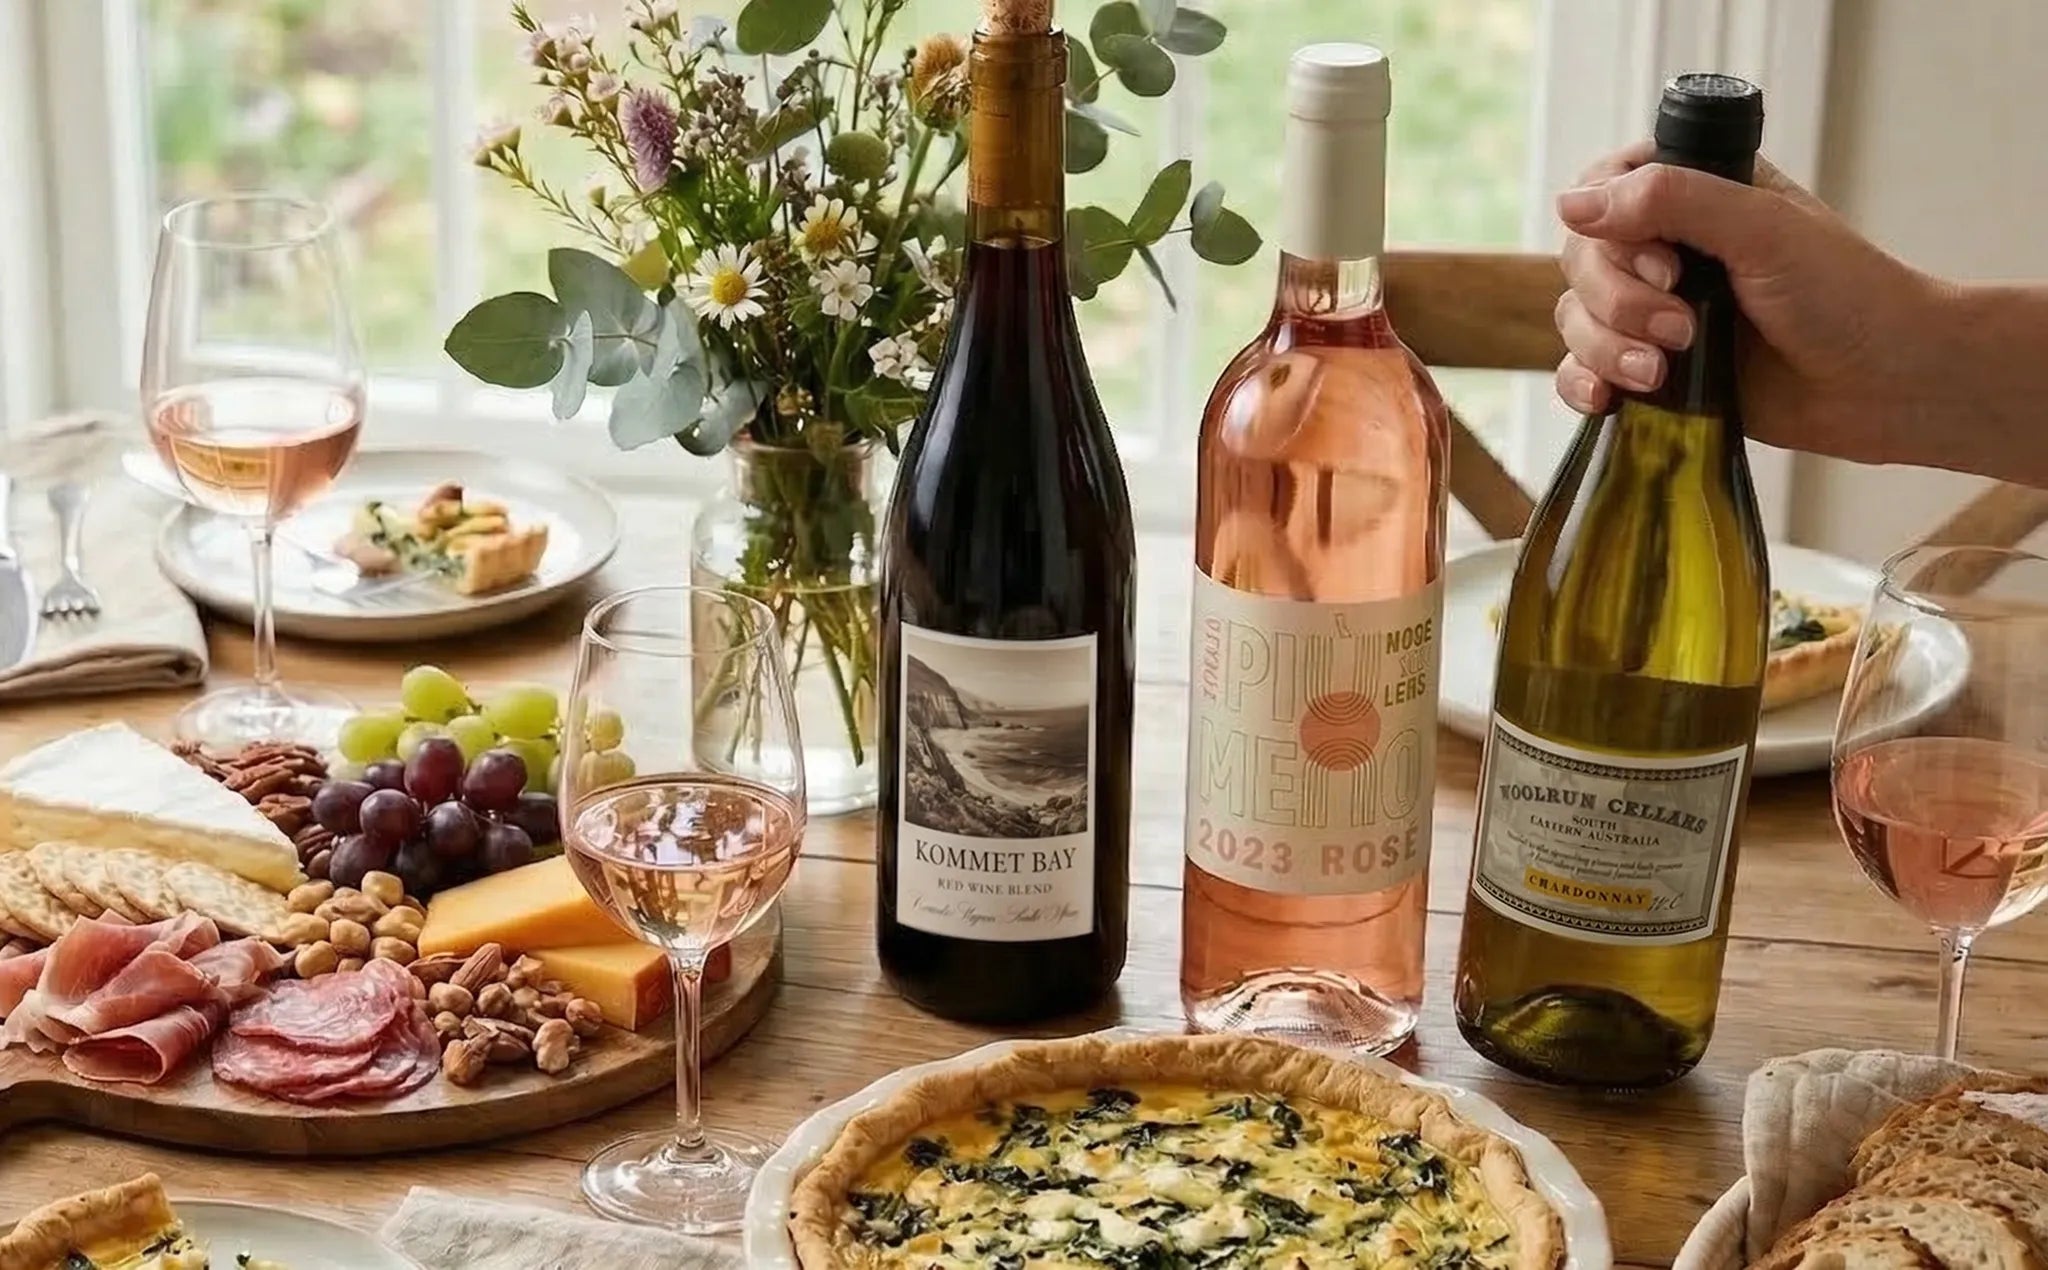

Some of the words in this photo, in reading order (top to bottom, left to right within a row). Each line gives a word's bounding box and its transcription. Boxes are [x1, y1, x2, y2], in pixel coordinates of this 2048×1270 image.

[1572, 815, 1617, 831] SOUTH
[916, 839, 1025, 874] KOMMET
[1032, 847, 1077, 873] BAY
[1199, 817, 1293, 874] 2023
[938, 877, 963, 892] RED
[968, 881, 1003, 895] WINE
[1008, 883, 1052, 896] BLEND
[1529, 874, 1646, 905] CHARDONNAY
